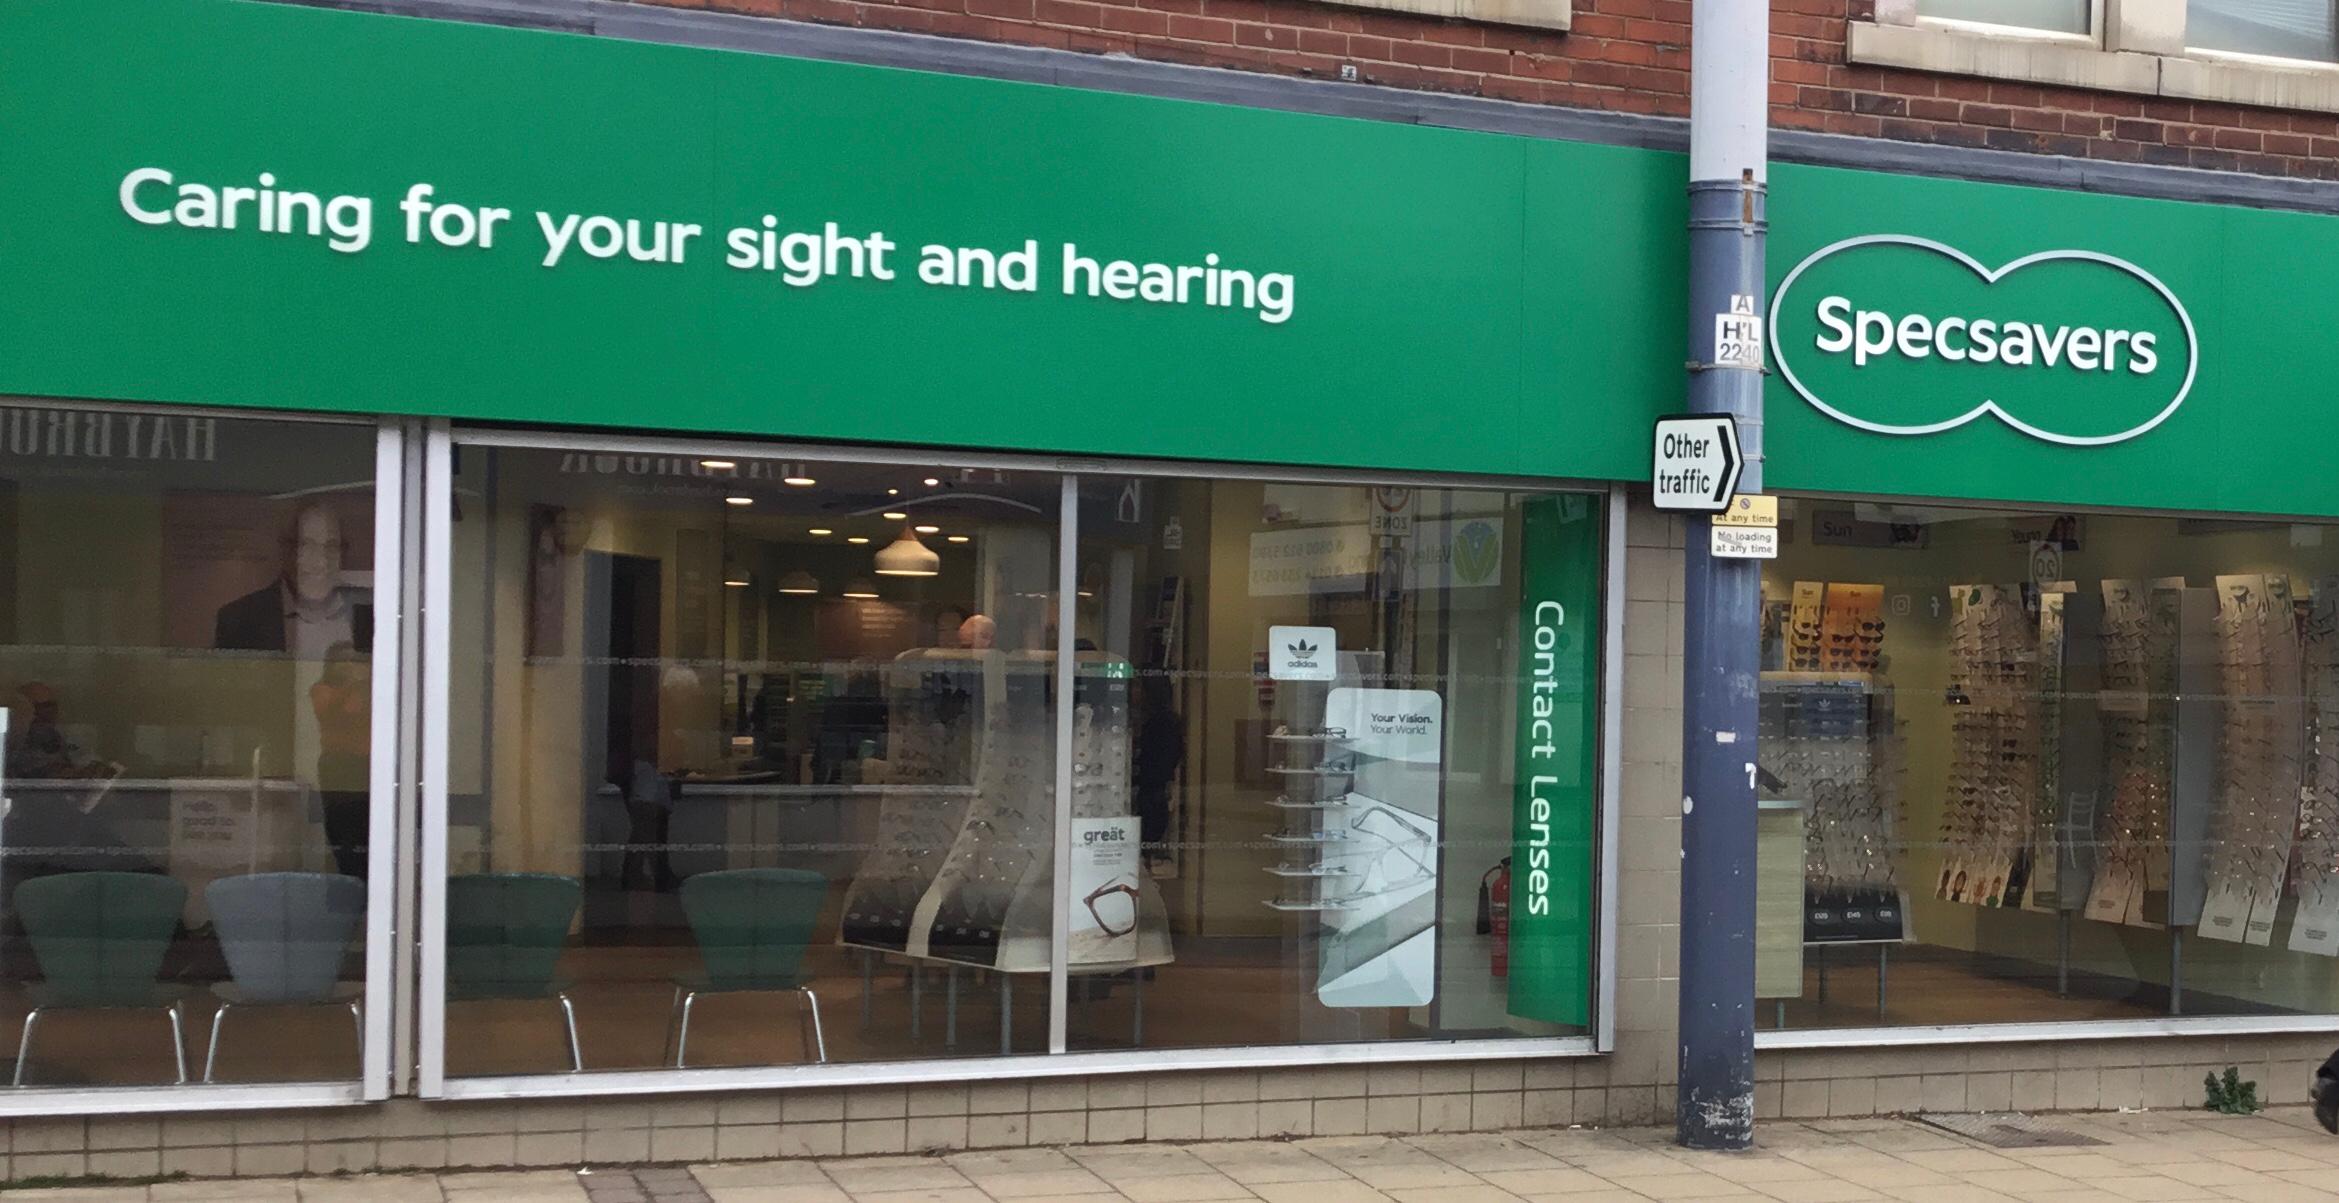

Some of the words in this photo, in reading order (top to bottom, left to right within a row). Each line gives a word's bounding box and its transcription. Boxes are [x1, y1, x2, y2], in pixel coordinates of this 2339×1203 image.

[119, 167, 372, 253] Caring
[399, 183, 511, 248] for
[535, 211, 702, 267] your
[726, 214, 896, 287] sight
[918, 239, 1038, 292] and
[1062, 242, 1295, 324] hearing
[1735, 294, 1751, 312] A
[1816, 295, 2158, 374] Specsavers
[1663, 433, 1710, 459] Other
[1659, 468, 1710, 494] traffic
[1752, 514, 1774, 523] time
[1823, 521, 1853, 536] Sun
[1736, 531, 1772, 543] loading
[1716, 544, 1726, 552] at
[1730, 545, 1747, 554] any
[1751, 544, 1773, 553] time
[1287, 660, 1319, 669] adidas
[1531, 601, 1564, 759] Contact
[1371, 713, 1395, 724] Your
[1399, 713, 1434, 724] Vision.
[1370, 724, 1393, 735] Your
[1396, 725, 1428, 736] World.
[1528, 775, 1558, 916] Lenses
